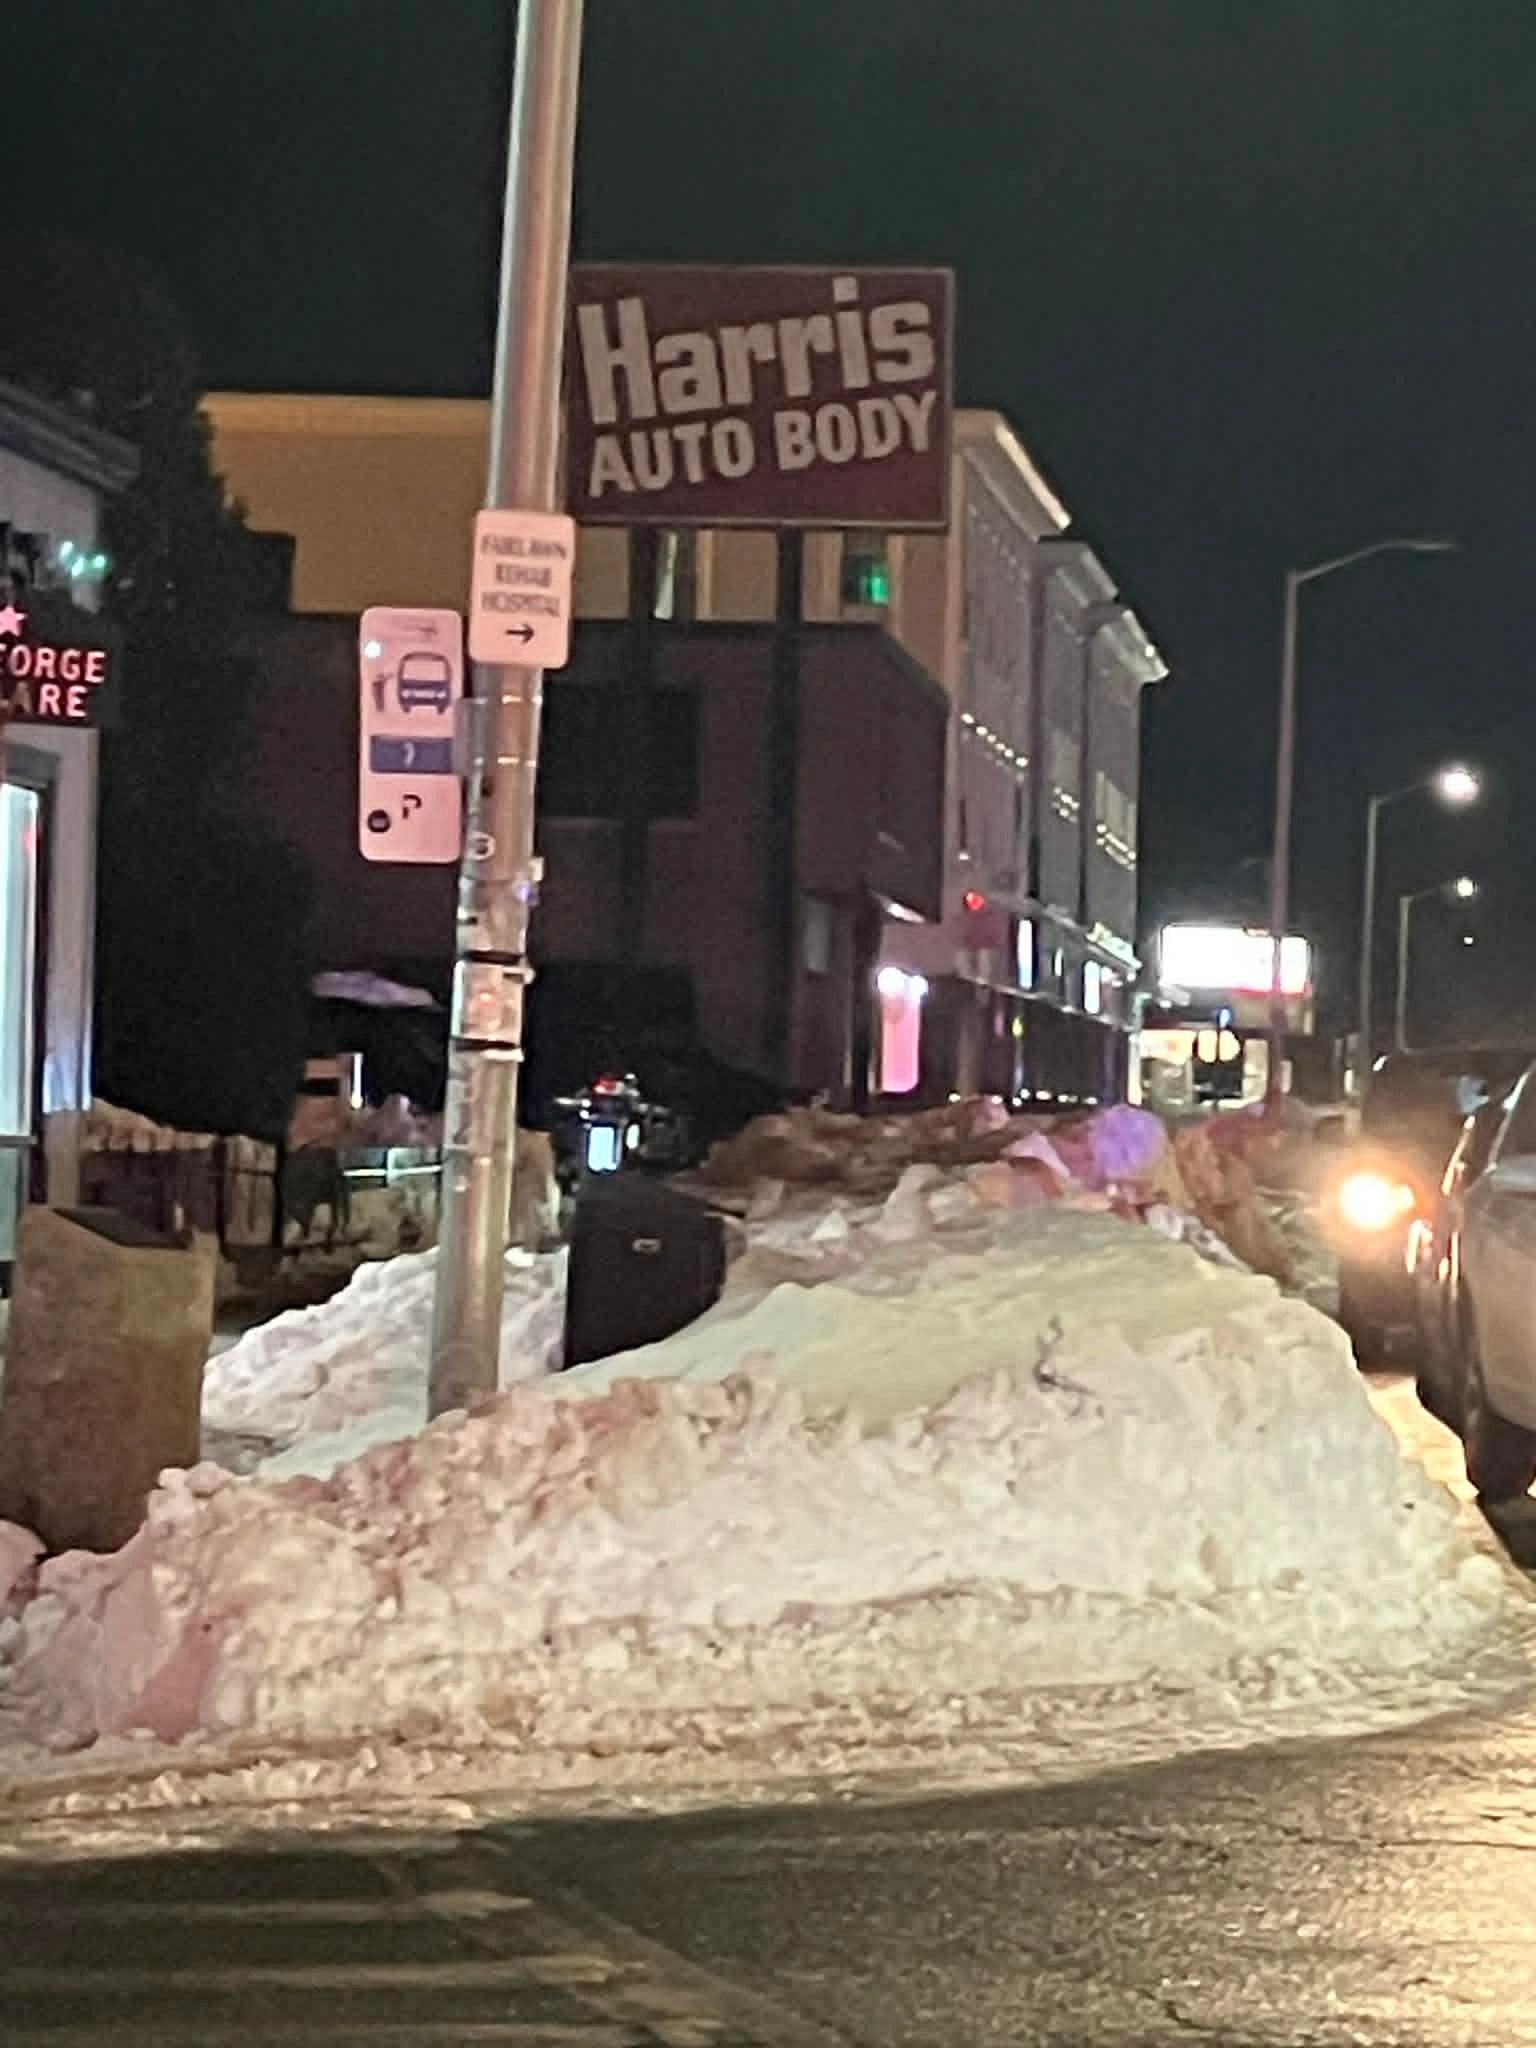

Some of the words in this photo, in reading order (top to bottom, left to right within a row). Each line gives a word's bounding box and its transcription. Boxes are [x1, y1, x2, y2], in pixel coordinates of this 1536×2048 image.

[577, 275, 936, 425] Harris
[588, 417, 756, 498] AUTO
[773, 390, 938, 472] BODY
[0, 681, 88, 718] ARE
